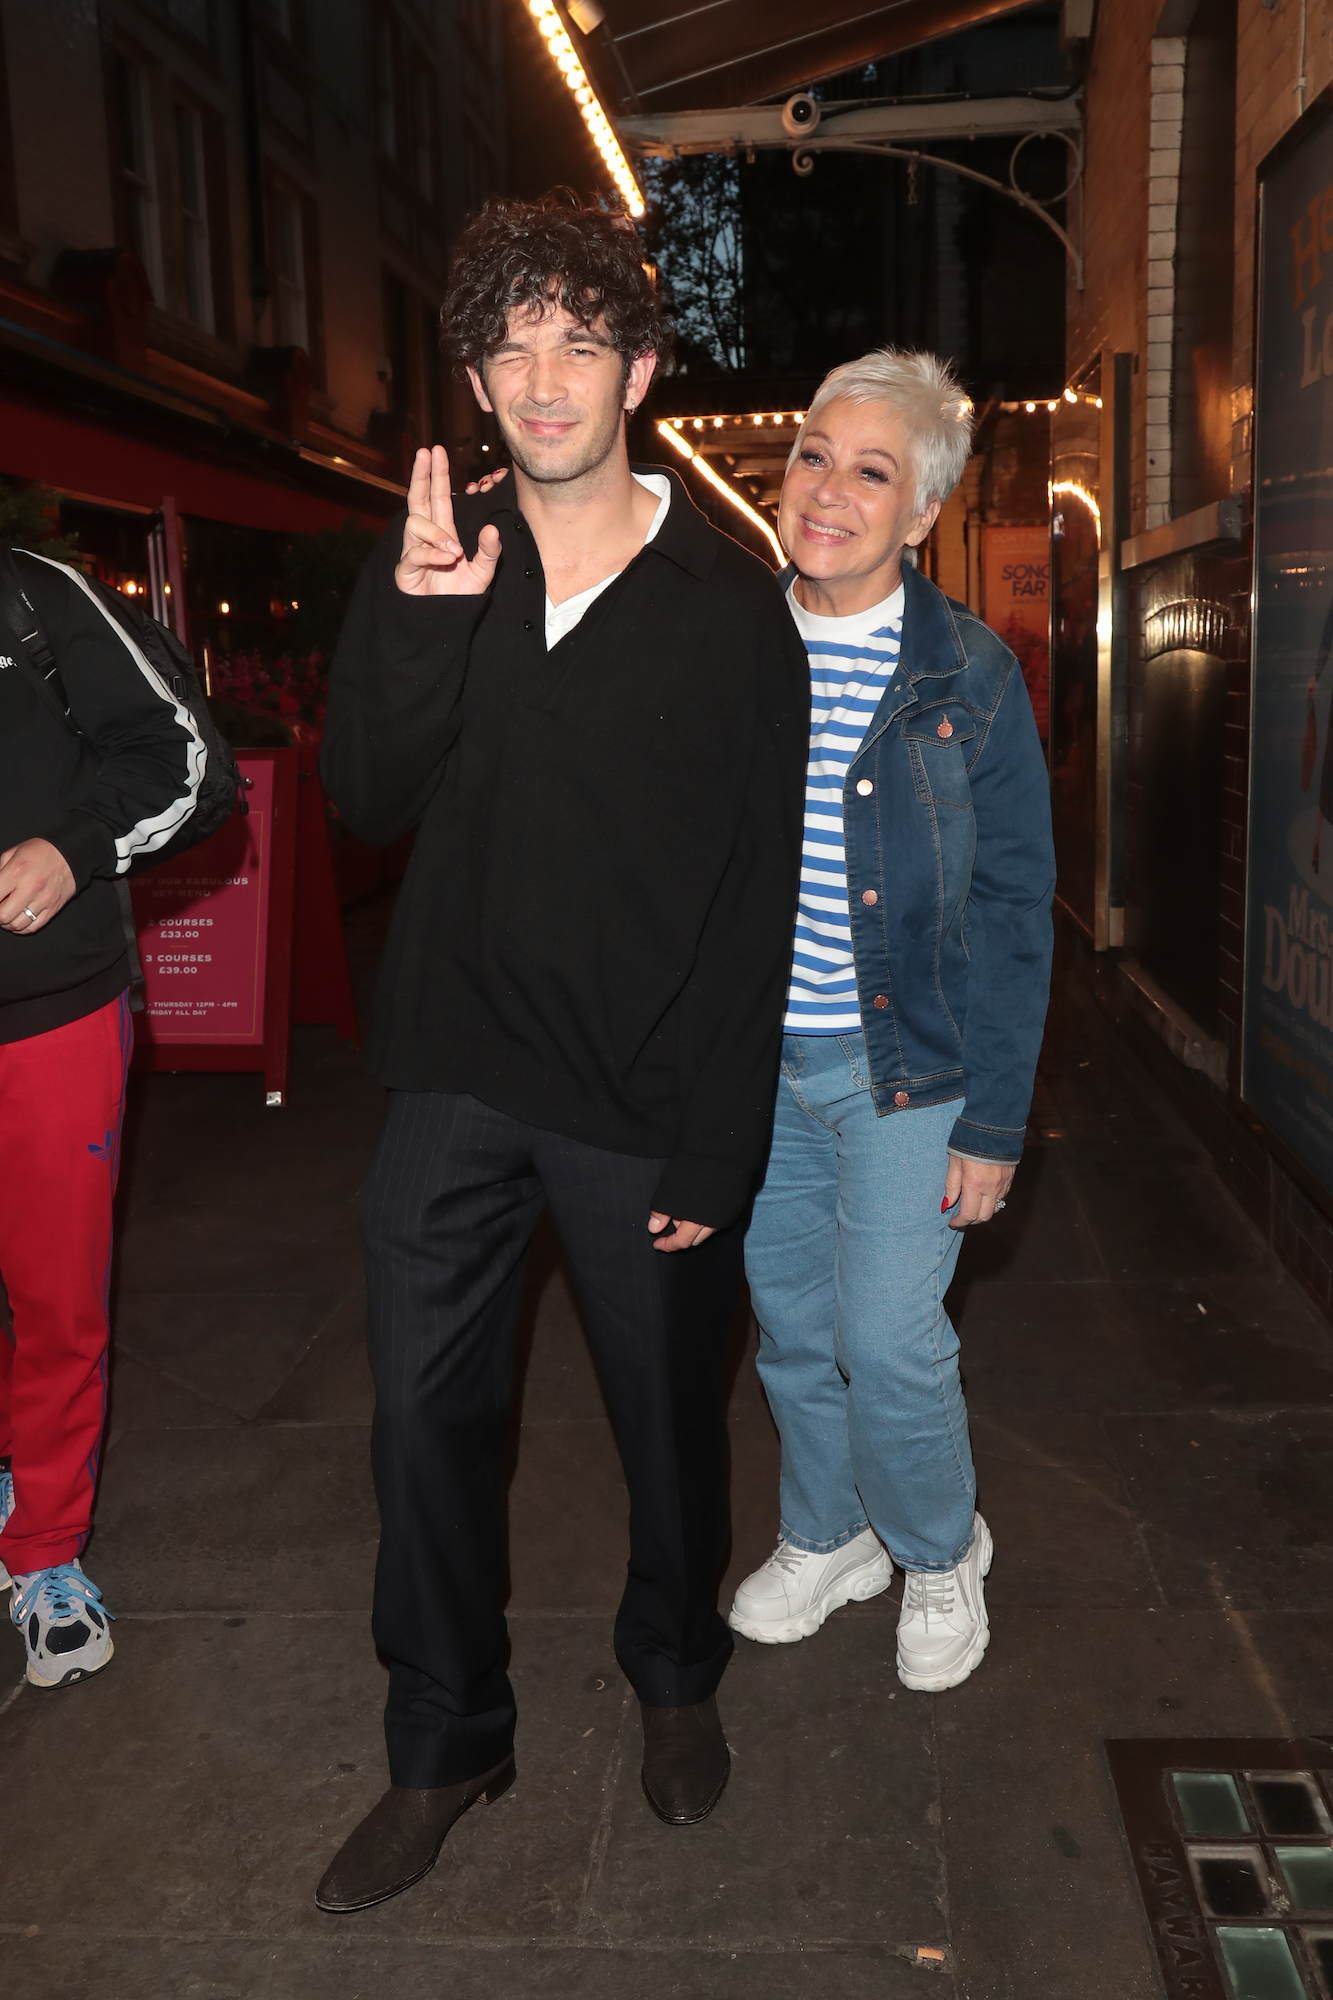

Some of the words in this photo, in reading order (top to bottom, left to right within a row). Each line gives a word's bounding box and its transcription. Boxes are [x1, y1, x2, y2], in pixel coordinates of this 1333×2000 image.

[1012, 580, 1046, 597] FAR
[157, 877, 181, 885] OUR
[187, 877, 249, 885] FABULOUS
[152, 890, 173, 898] SET
[178, 890, 211, 898] MENU
[159, 918, 213, 926] COURSES
[160, 930, 200, 938] £33.00
[145, 954, 153, 962] 3
[157, 954, 212, 962] COURSES
[158, 966, 198, 974] £39.00
